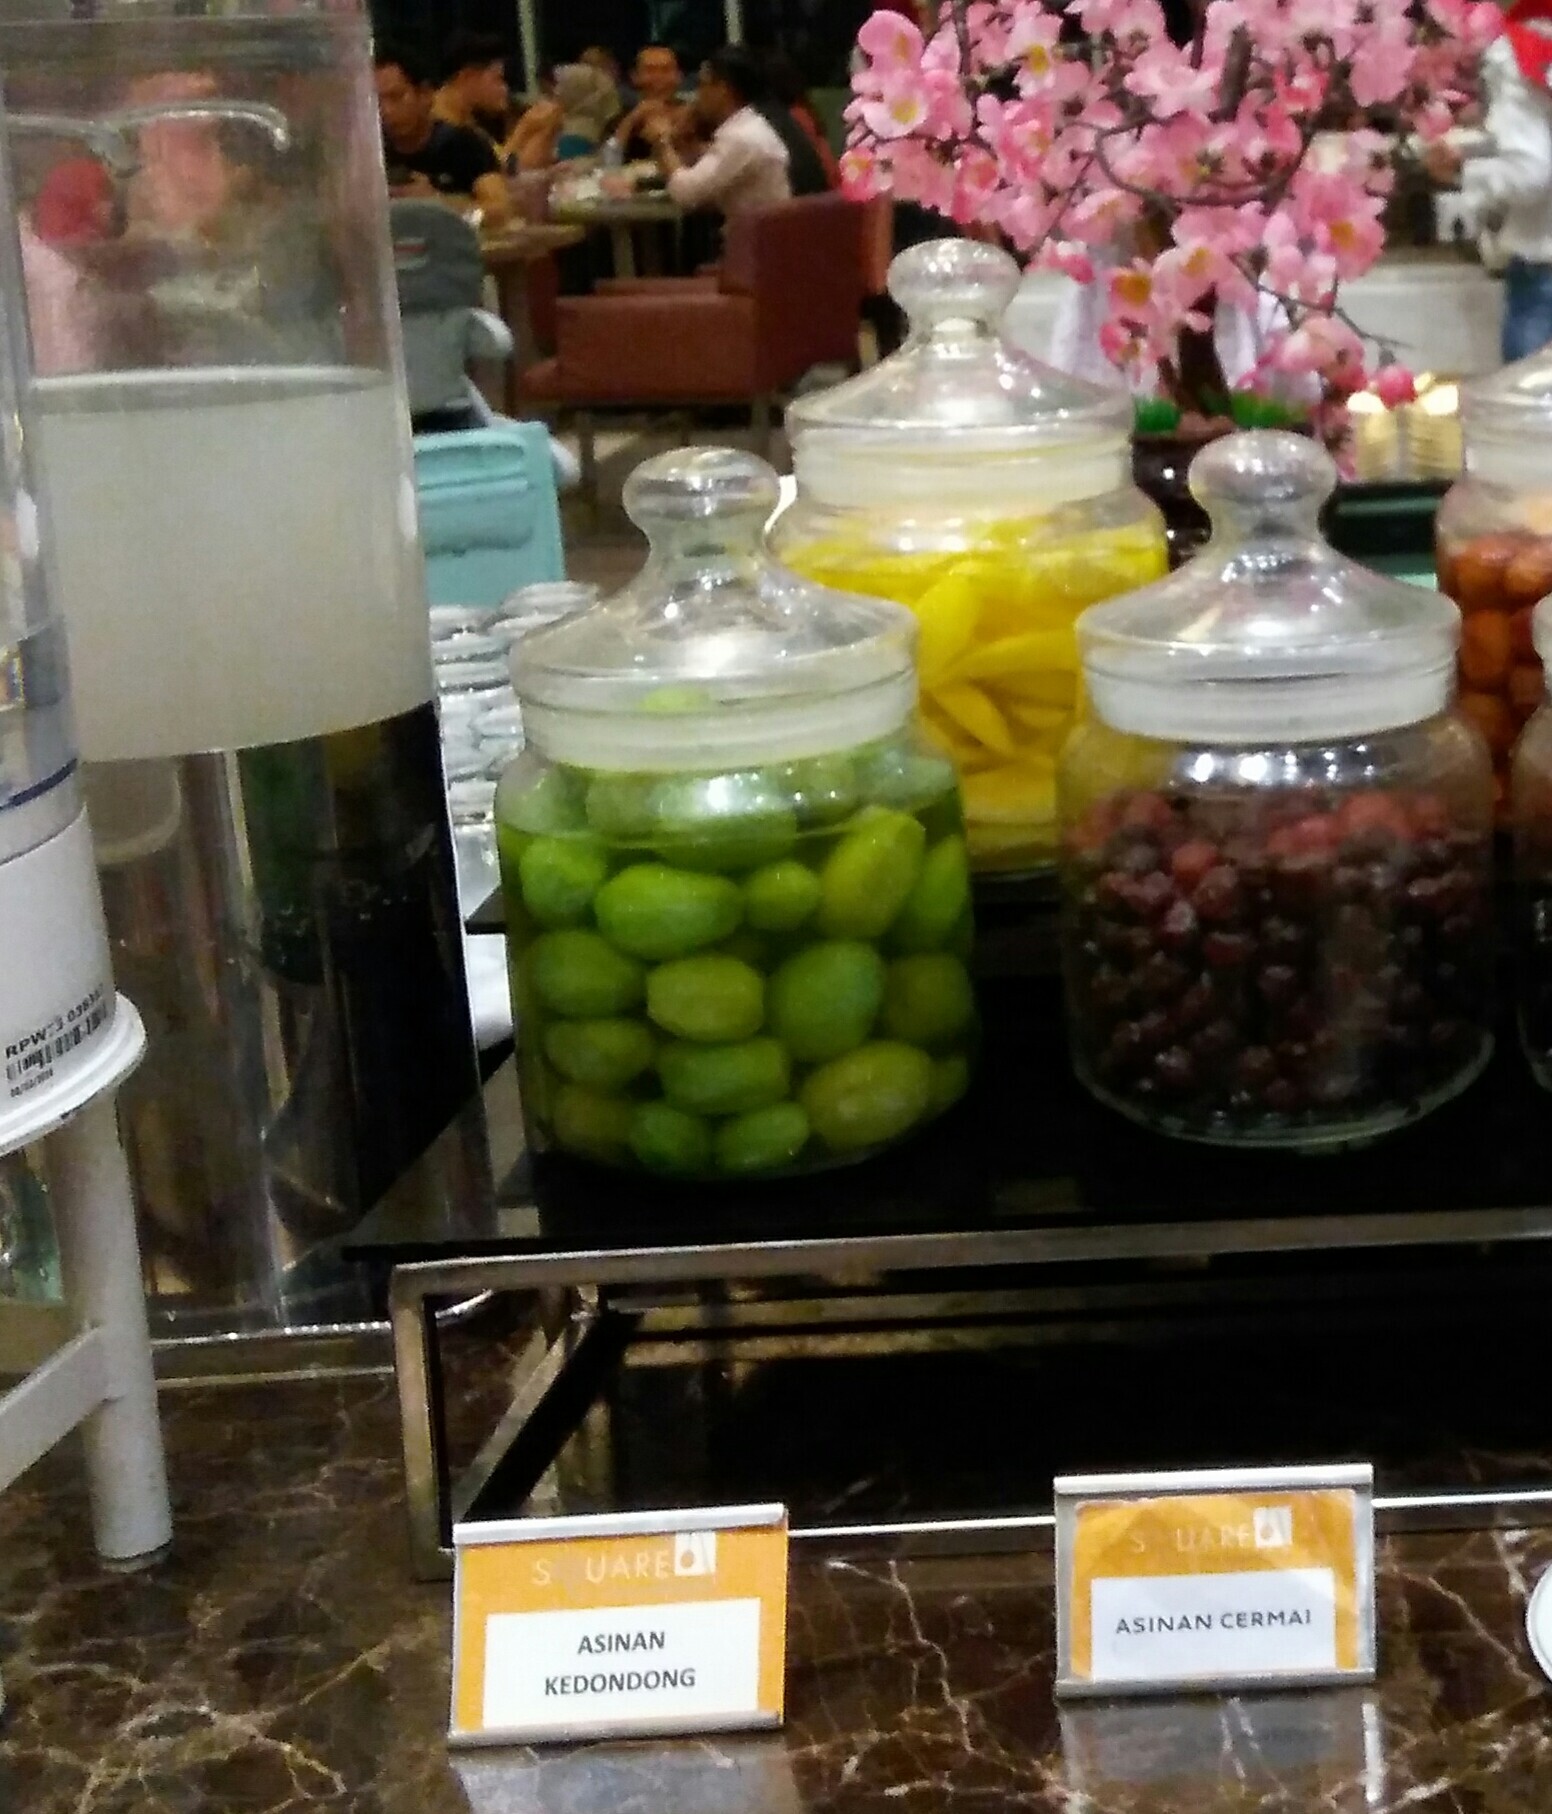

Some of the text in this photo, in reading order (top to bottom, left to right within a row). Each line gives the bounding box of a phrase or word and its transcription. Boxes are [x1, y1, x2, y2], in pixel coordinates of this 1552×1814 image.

[1116, 1609, 1311, 1635] ASINAN CERMAI
[577, 1630, 666, 1655] ASINAN
[544, 1667, 696, 1696] KEDONDONG
